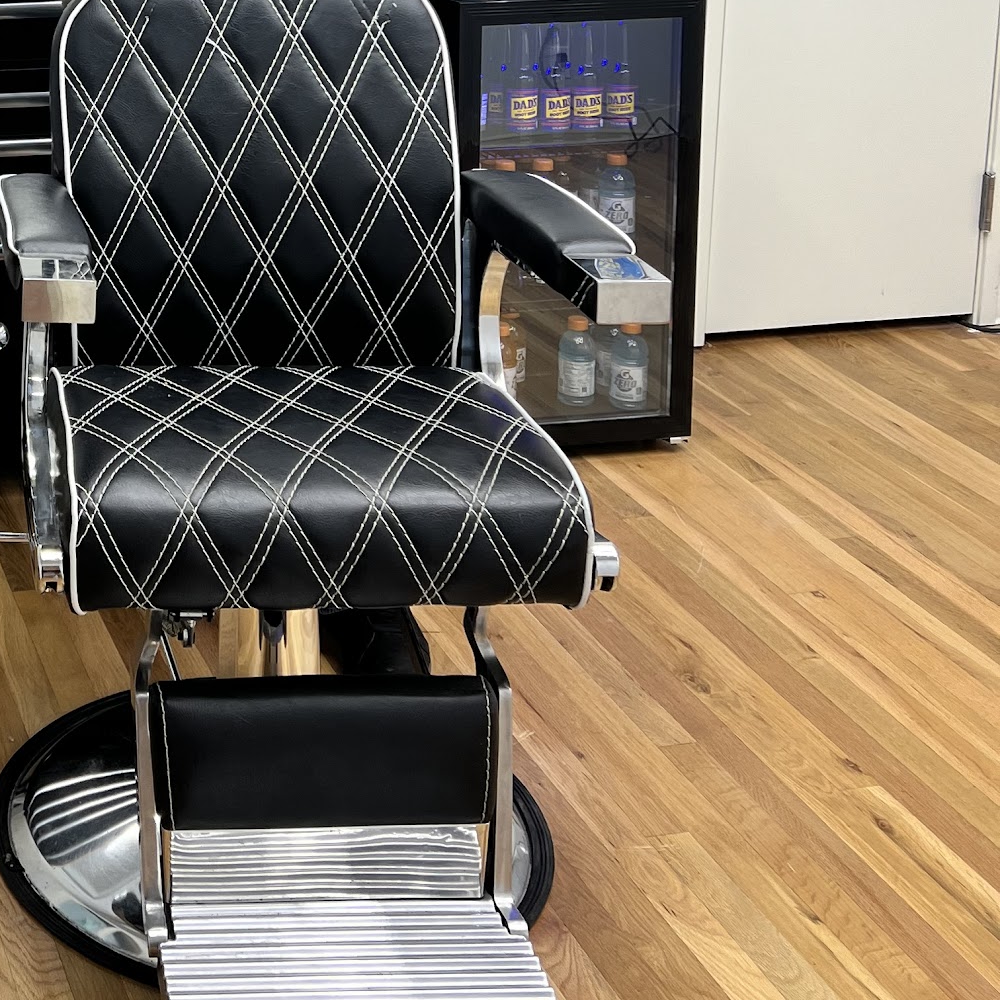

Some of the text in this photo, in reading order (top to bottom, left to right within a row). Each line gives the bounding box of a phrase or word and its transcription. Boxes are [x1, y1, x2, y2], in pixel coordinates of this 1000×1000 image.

[611, 201, 622, 212] G
[605, 210, 629, 220] ZERO
[620, 368, 631, 379] G
[613, 377, 637, 389] ZERO
